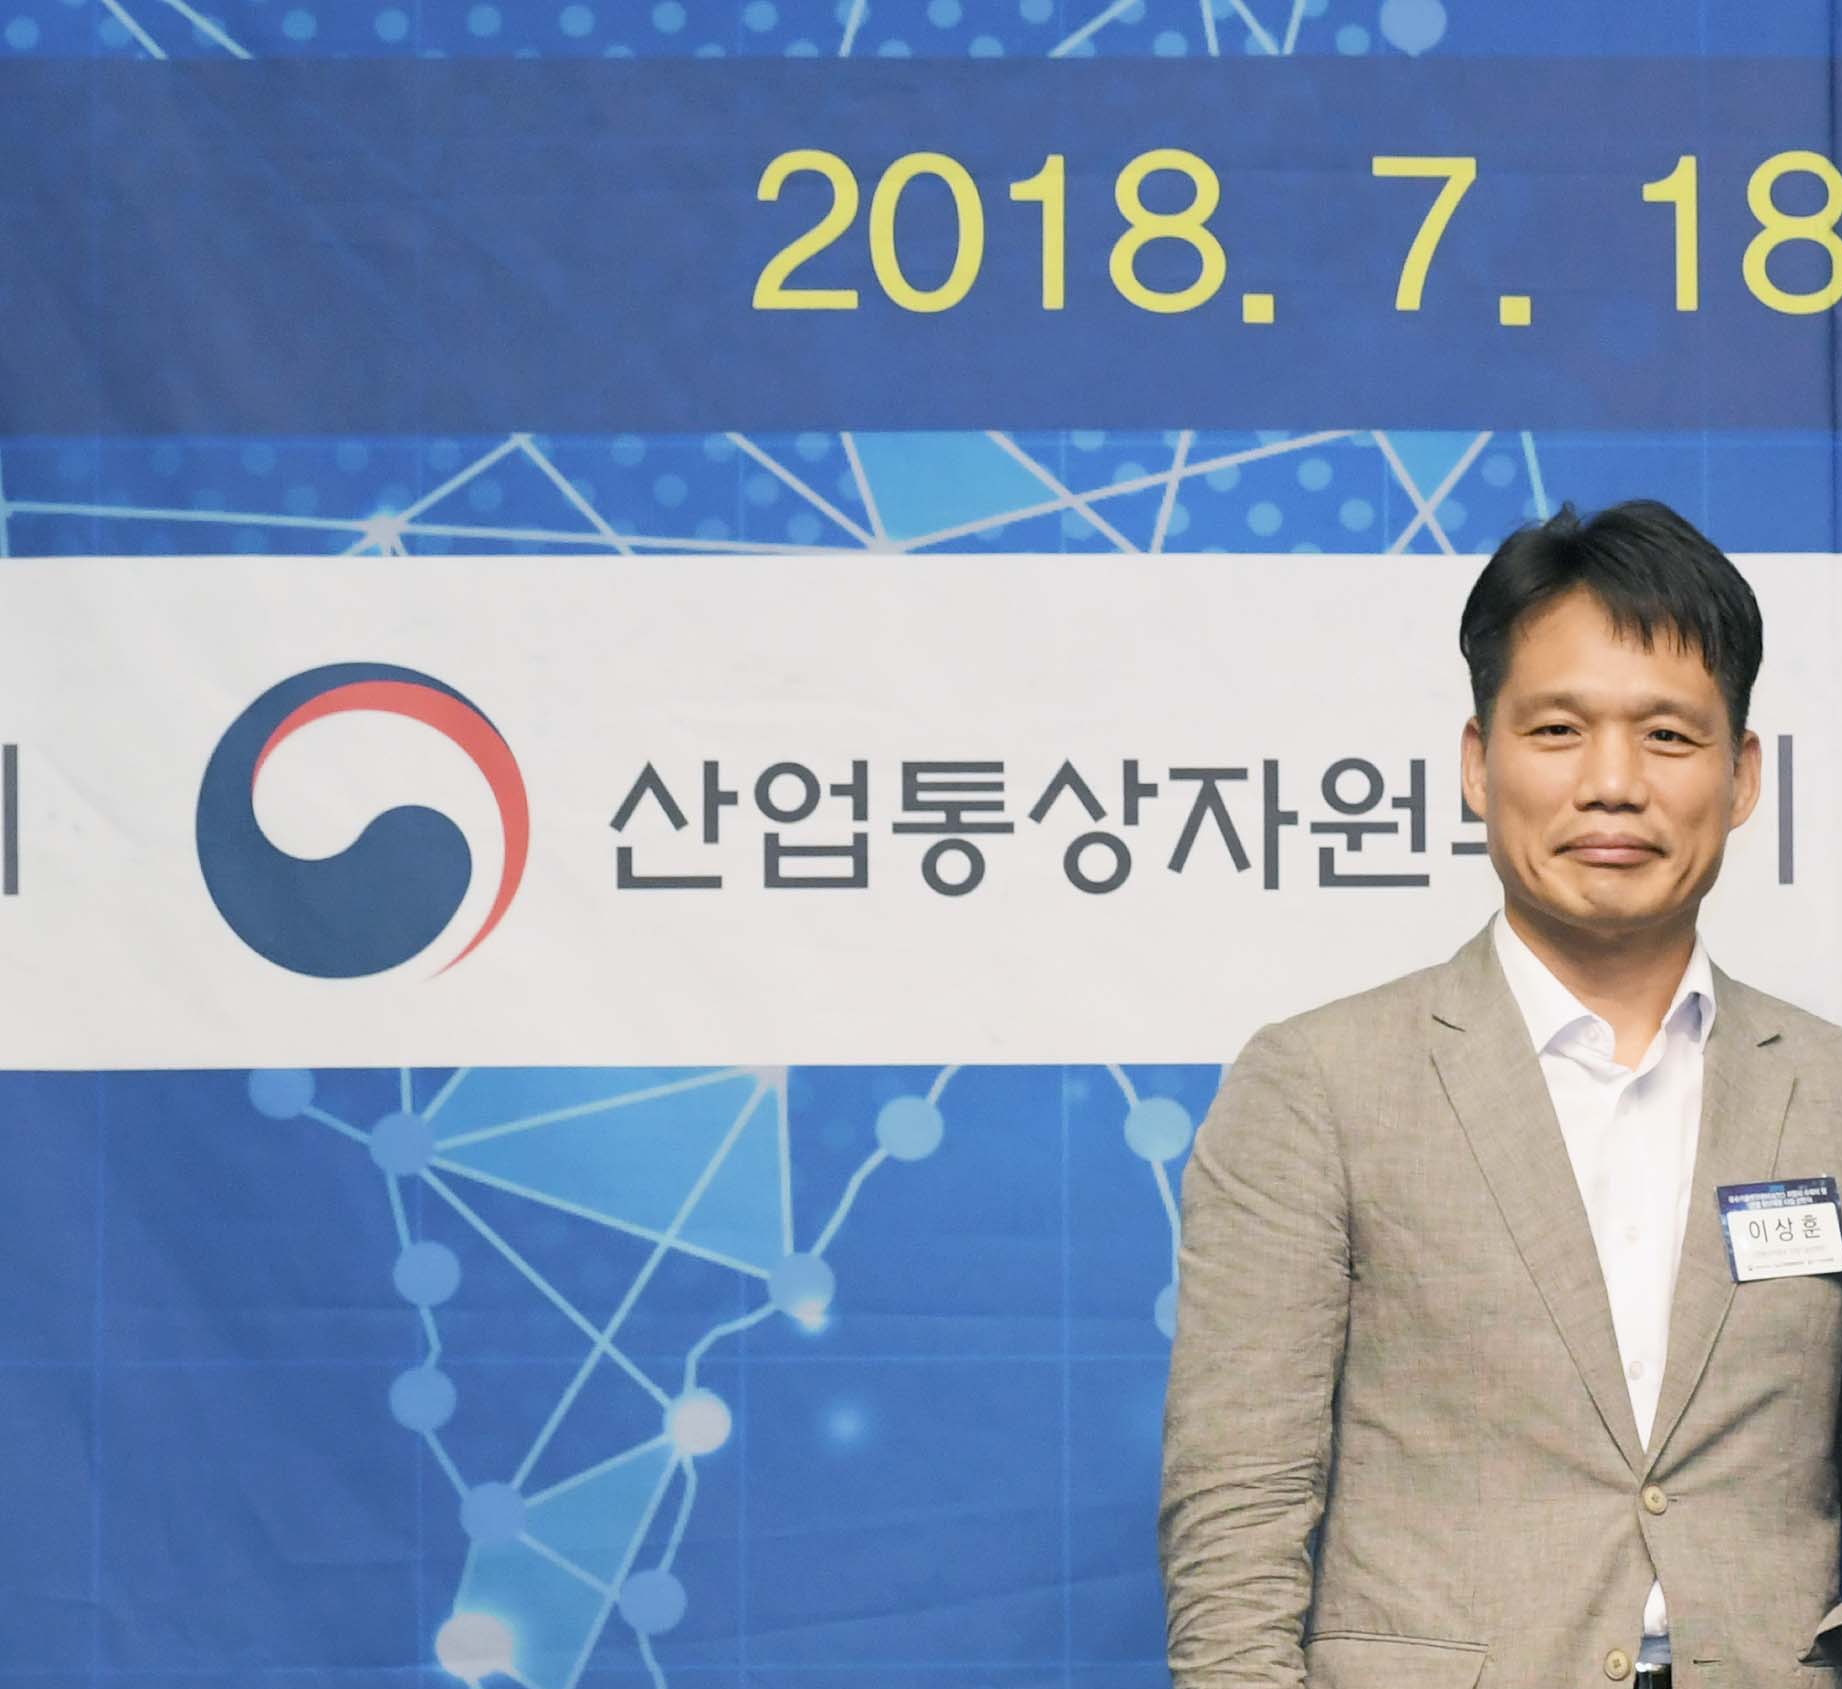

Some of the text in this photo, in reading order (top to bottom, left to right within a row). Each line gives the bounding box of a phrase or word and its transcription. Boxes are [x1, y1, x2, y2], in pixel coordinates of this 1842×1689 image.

[752, 148, 1276, 324] 2018.
[1371, 156, 1533, 326] 7.
[609, 758, 1489, 896] 산업통상자원
